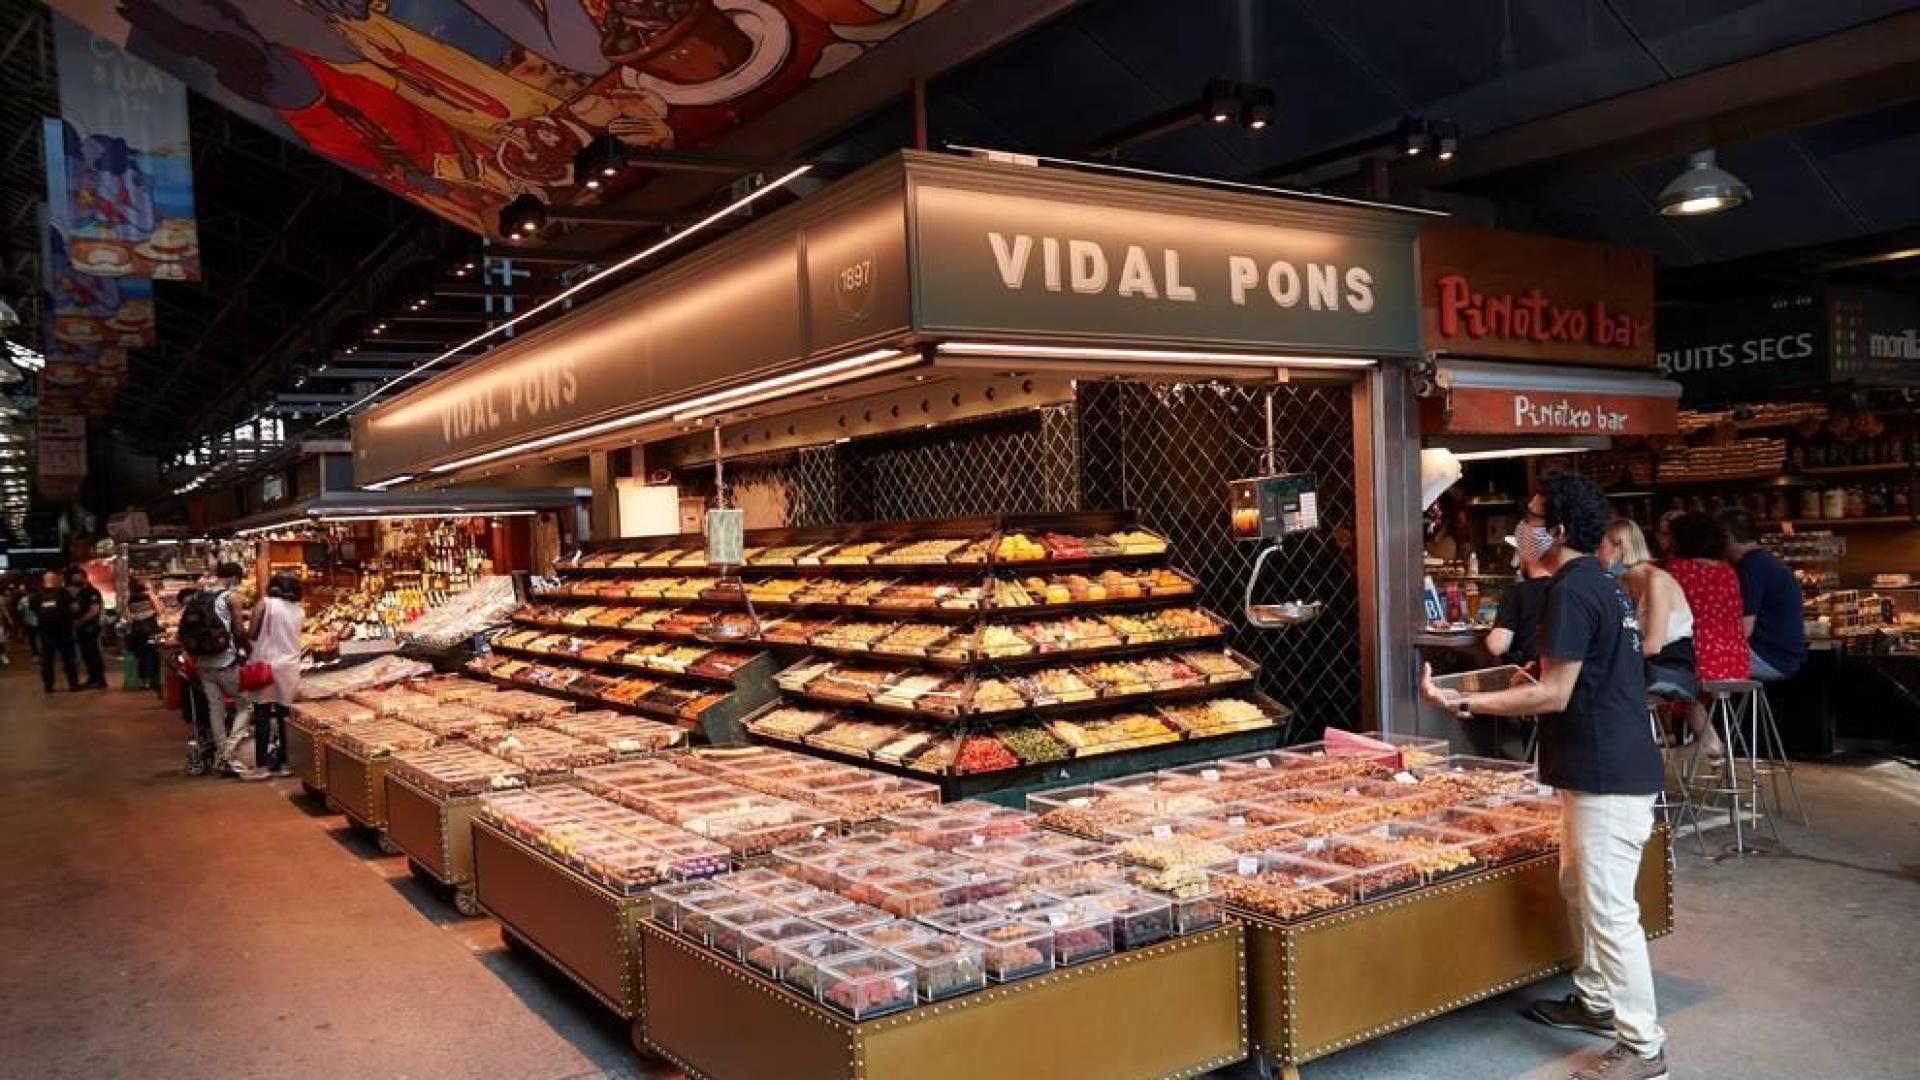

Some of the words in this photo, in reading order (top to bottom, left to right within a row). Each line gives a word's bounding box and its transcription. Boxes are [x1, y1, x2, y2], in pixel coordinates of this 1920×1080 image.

[840, 260, 871, 293] 1897
[988, 232, 1197, 301] VIDAL
[1229, 255, 1375, 313] PONS
[1591, 301, 1648, 347] bar
[1656, 343, 1735, 375] RUITS
[1741, 332, 1814, 364] SECS
[441, 387, 500, 443] VIDAL
[511, 358, 577, 424] PONS
[1597, 404, 1629, 430] bar
